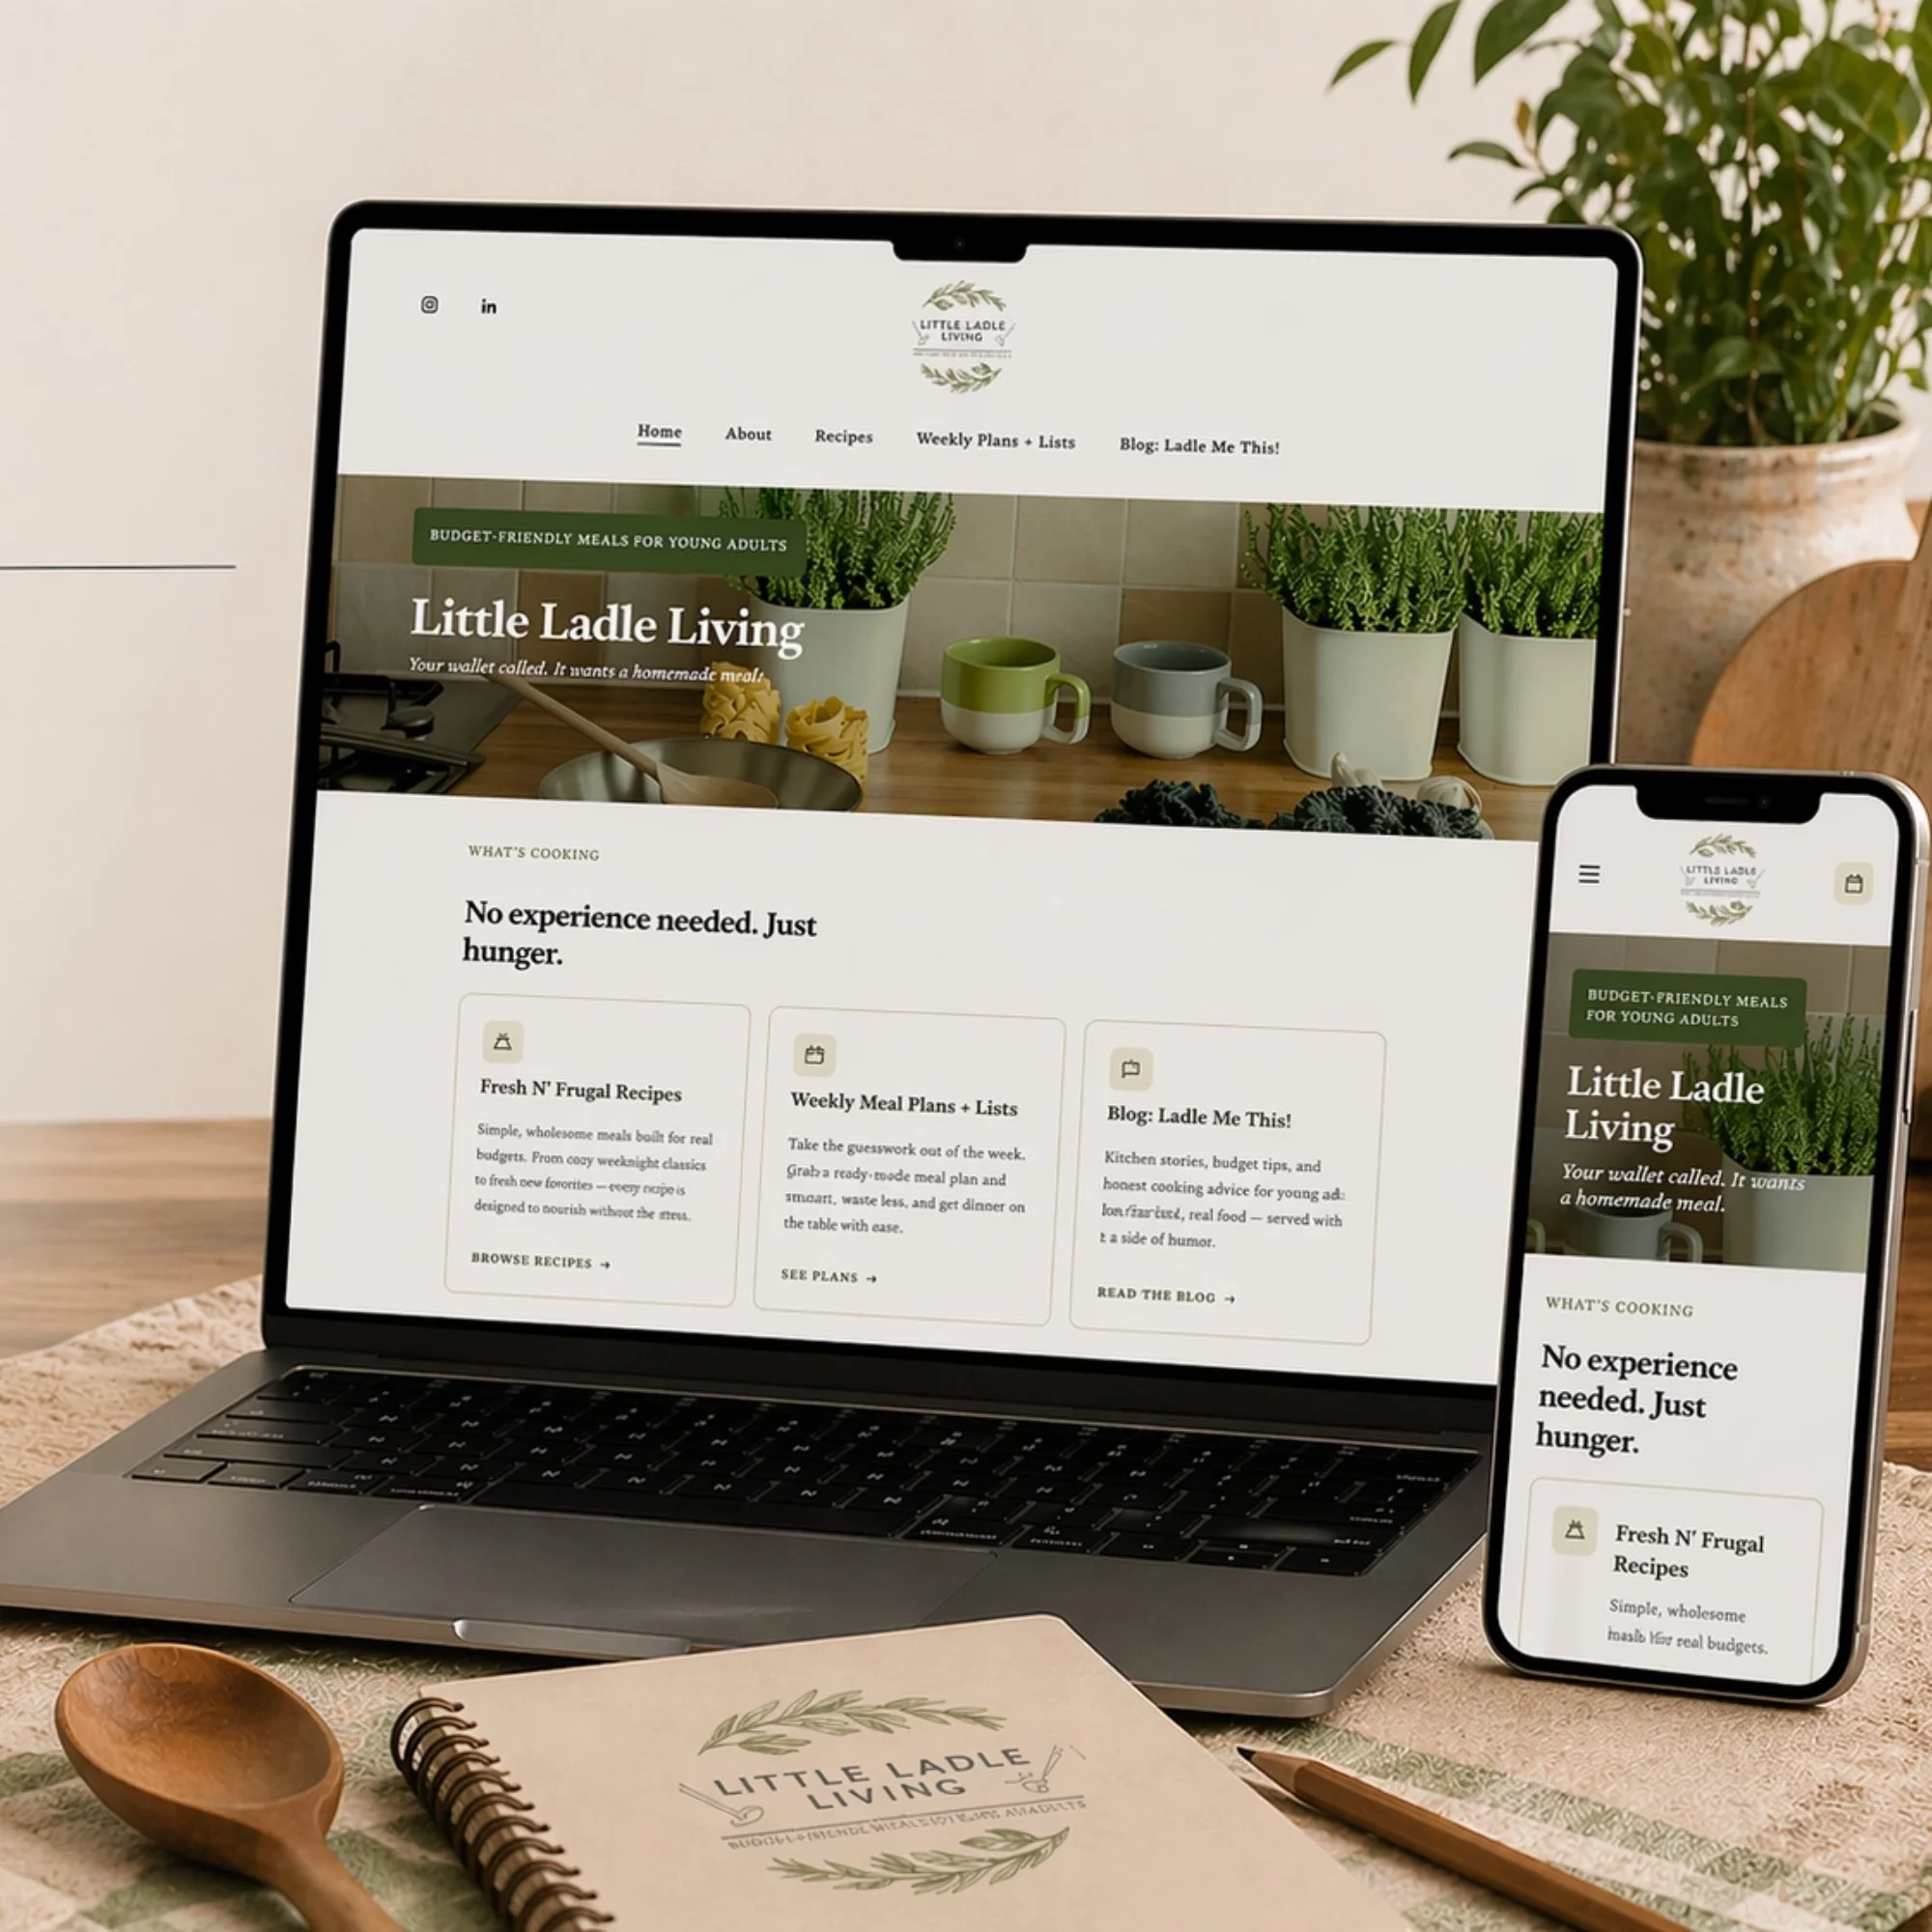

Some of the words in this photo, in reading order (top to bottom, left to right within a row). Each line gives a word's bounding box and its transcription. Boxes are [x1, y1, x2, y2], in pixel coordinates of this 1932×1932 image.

[921, 320, 960, 330] LITTLE
[966, 321, 1005, 330] LADLE
[942, 332, 982, 342] LIVING
[639, 424, 682, 438] Home
[725, 427, 771, 440] About
[815, 430, 873, 446] Recipes
[917, 432, 972, 449] Weekly
[978, 433, 1018, 447] Plans
[1039, 436, 1075, 449] Lists
[1121, 437, 1158, 454] Blog:
[1165, 439, 1206, 453] Ladle
[1211, 440, 1235, 453] Me
[1240, 440, 1279, 454] This!
[431, 529, 572, 545] BUDGET-FRIENDLY
[578, 534, 628, 547] MEALS
[634, 535, 663, 548] FOR
[669, 537, 721, 549] YOUNG
[727, 539, 786, 552] ADULTS
[412, 598, 528, 638] Little
[540, 603, 657, 642] Ladle
[668, 608, 805, 660] Living
[411, 657, 444, 671] Your
[448, 658, 495, 673] wallet
[554, 662, 566, 675] It
[570, 667, 615, 678] wants
[618, 668, 628, 678] a
[633, 664, 717, 681] homemade
[469, 845, 526, 858] WHAT'S
[530, 847, 599, 861] COOKING
[466, 900, 503, 923] No
[509, 904, 650, 933] experience
[657, 909, 757, 934] needed.
[763, 913, 816, 939] Just
[463, 937, 562, 971] hunger.
[1588, 989, 1731, 1006] BUDGET-FRIENDLY
[1736, 996, 1787, 1008] MEALS
[1587, 1009, 1615, 1021] FOR
[1621, 1010, 1674, 1024] YOUNG
[1680, 1013, 1739, 1027] ADULTS
[481, 1079, 526, 1094] Fresh
[556, 1082, 611, 1102] Frugal
[616, 1085, 682, 1105] Recipes
[1568, 1065, 1661, 1098] Little
[1669, 1071, 1764, 1104] Ladle
[791, 1092, 855, 1113] Weekly
[860, 1094, 902, 1111] Meal
[909, 1096, 955, 1113] Plans
[976, 1100, 1017, 1116] Lists
[1108, 1105, 1152, 1126] Blog:
[1159, 1108, 1207, 1124] Ladle
[1213, 1110, 1240, 1126] Me
[1245, 1112, 1291, 1128] This!
[478, 1122, 522, 1139] Simple,
[526, 1125, 593, 1140] wholesome
[597, 1129, 632, 1141] meals
[668, 1131, 686, 1144] for
[691, 1133, 713, 1145] real
[1566, 1109, 1675, 1152] Living
[532, 1151, 563, 1164] From
[788, 1138, 819, 1151] Take
[823, 1139, 843, 1151] the
[847, 1143, 916, 1155] guesswork
[920, 1147, 941, 1156] out
[946, 1145, 960, 1157] of
[963, 1146, 984, 1158] the
[988, 1148, 1025, 1160] week.
[1105, 1151, 1156, 1165] Kitchen
[1160, 1155, 1208, 1169] stories,
[1212, 1155, 1258, 1173] budget
[1263, 1159, 1292, 1175] tips,
[1296, 1160, 1321, 1173] and
[475, 1176, 487, 1185] to
[489, 1174, 517, 1186] fresh
[915, 1171, 946, 1183] meal
[950, 1173, 978, 1187] plan
[981, 1174, 1007, 1185] and
[1563, 1163, 1604, 1179] Your
[1608, 1165, 1664, 1183] wallet
[1668, 1168, 1725, 1186] called.
[1731, 1173, 1746, 1187] It
[1751, 1175, 1805, 1190] wants
[1103, 1177, 1147, 1191] honest
[1151, 1180, 1204, 1198] cooking
[1208, 1181, 1250, 1196] advice
[1254, 1184, 1274, 1197] for
[1277, 1190, 1319, 1203] young
[528, 1205, 540, 1213] to
[842, 1196, 877, 1206] waste
[912, 1197, 935, 1209] and
[939, 1201, 958, 1212] get
[962, 1198, 1005, 1212] dinner
[1009, 1204, 1025, 1212] on
[1560, 1194, 1571, 1205] a
[1576, 1192, 1672, 1209] homemade
[1677, 1195, 1725, 1212] meal.
[784, 1215, 804, 1229] the
[808, 1217, 838, 1231] table
[840, 1219, 868, 1232] with
[871, 1224, 903, 1233] ease.
[1189, 1208, 1213, 1221] real
[1217, 1208, 1246, 1223] food
[1267, 1213, 1310, 1225] served
[1313, 1214, 1343, 1227] with
[1110, 1235, 1118, 1243] a
[1122, 1232, 1148, 1244] side
[1151, 1233, 1165, 1245] of
[1168, 1233, 1215, 1247] humor.
[471, 1253, 528, 1265] BROWSE
[534, 1256, 591, 1268] RECIPES
[781, 1269, 807, 1280] SEE
[813, 1270, 857, 1283] PLANS
[1097, 1287, 1136, 1298] READ
[1142, 1290, 1171, 1300] THE
[1177, 1291, 1215, 1303] BLOG
[1547, 1296, 1609, 1313] WHAT'S
[1615, 1301, 1692, 1318] COOKING
[1542, 1345, 1581, 1370] No
[1588, 1352, 1738, 1380] experience
[1540, 1386, 1644, 1413] needed.
[1649, 1391, 1706, 1420] Just
[1536, 1421, 1638, 1458] hunger.
[1616, 1525, 1668, 1545] Fresh
[1702, 1532, 1764, 1556] Frugal
[1614, 1555, 1689, 1580] Recipes
[1609, 1599, 1662, 1617] Simple,
[1667, 1604, 1746, 1623] wholesome
[1677, 1634, 1702, 1649] real
[1707, 1635, 1768, 1656] budgets.
[714, 1766, 872, 1797] LITTLE
[886, 1748, 1032, 1778] LADLE
[808, 1778, 967, 1812] LIVING
